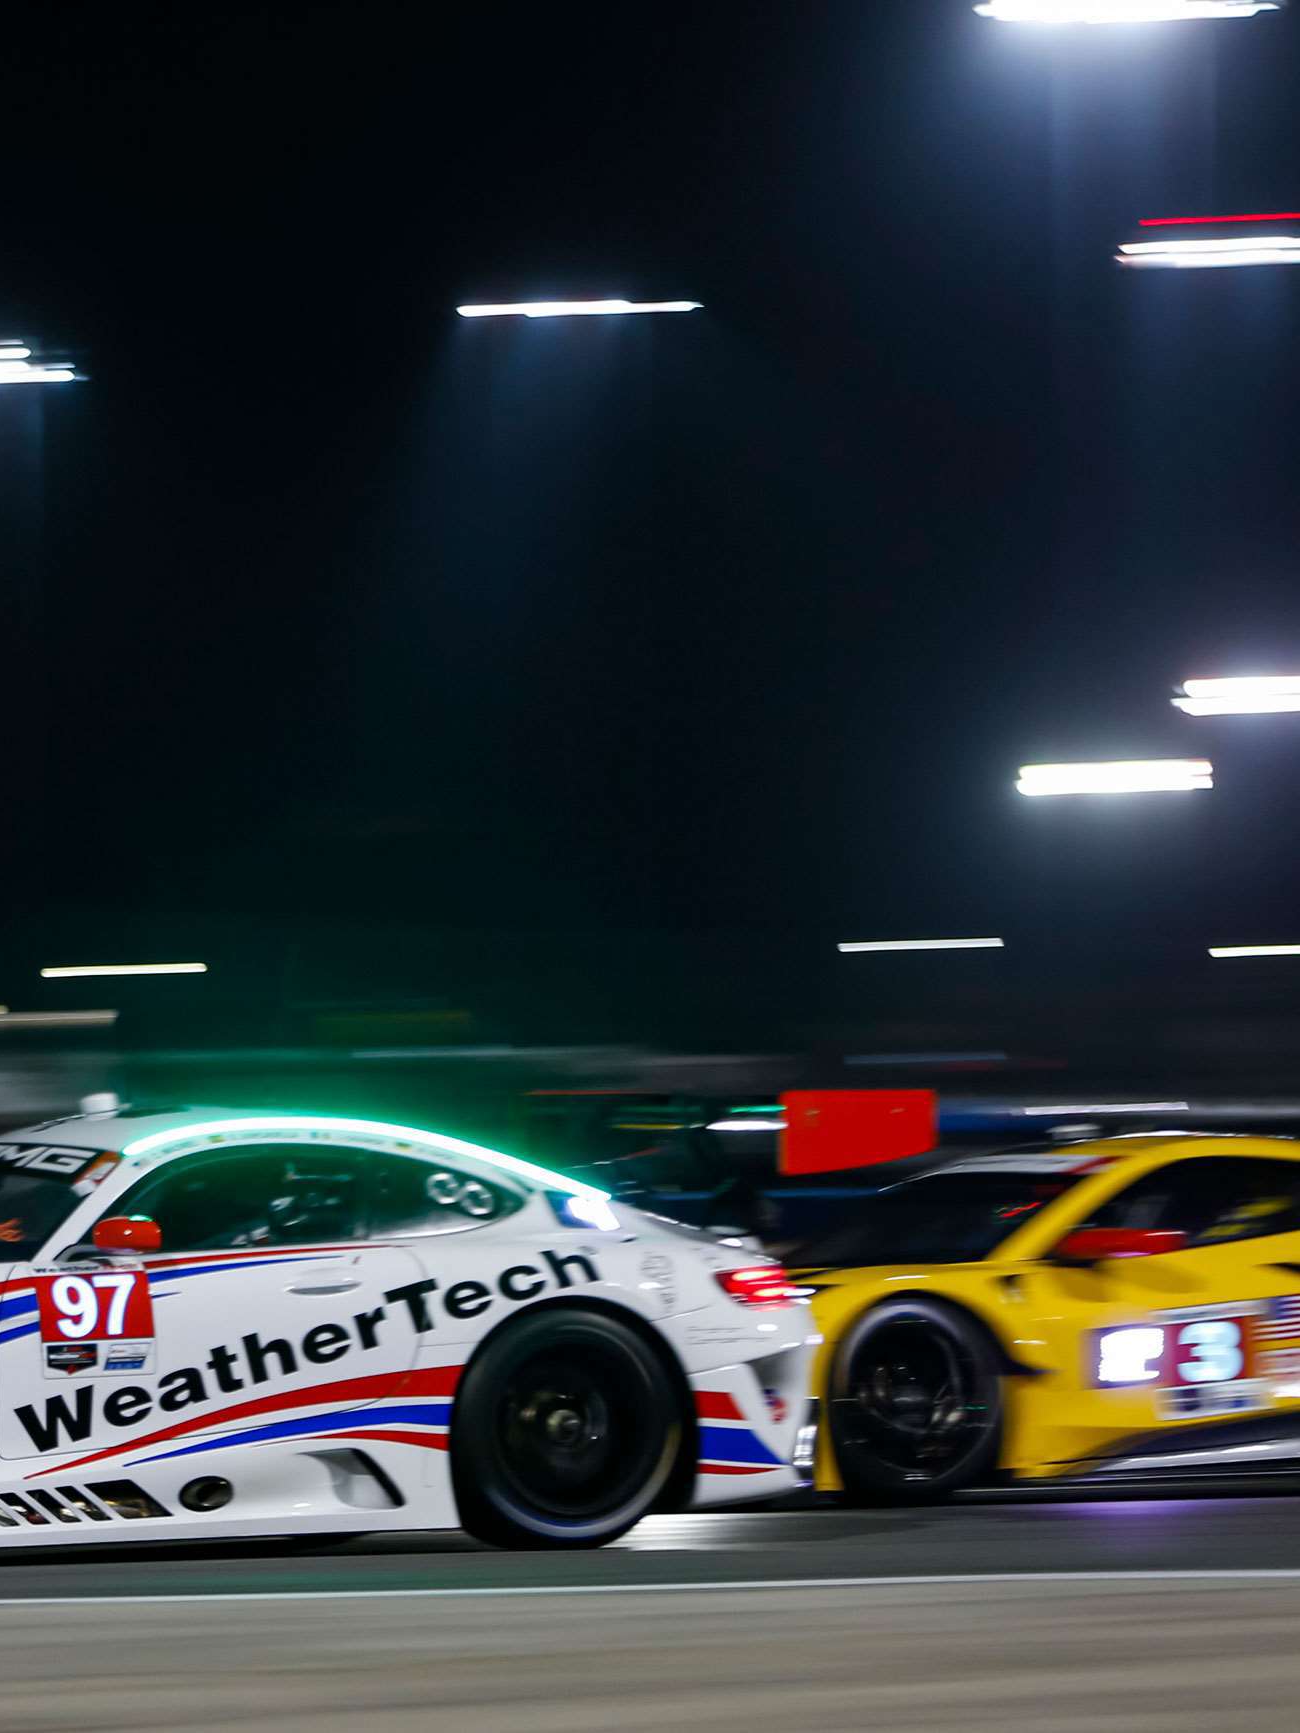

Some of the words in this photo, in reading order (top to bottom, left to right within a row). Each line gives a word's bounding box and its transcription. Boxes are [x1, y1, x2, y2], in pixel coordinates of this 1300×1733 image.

[51, 1273, 136, 1339] 97
[13, 1248, 600, 1453] WeatherTech
[1177, 1321, 1244, 1383] 3
